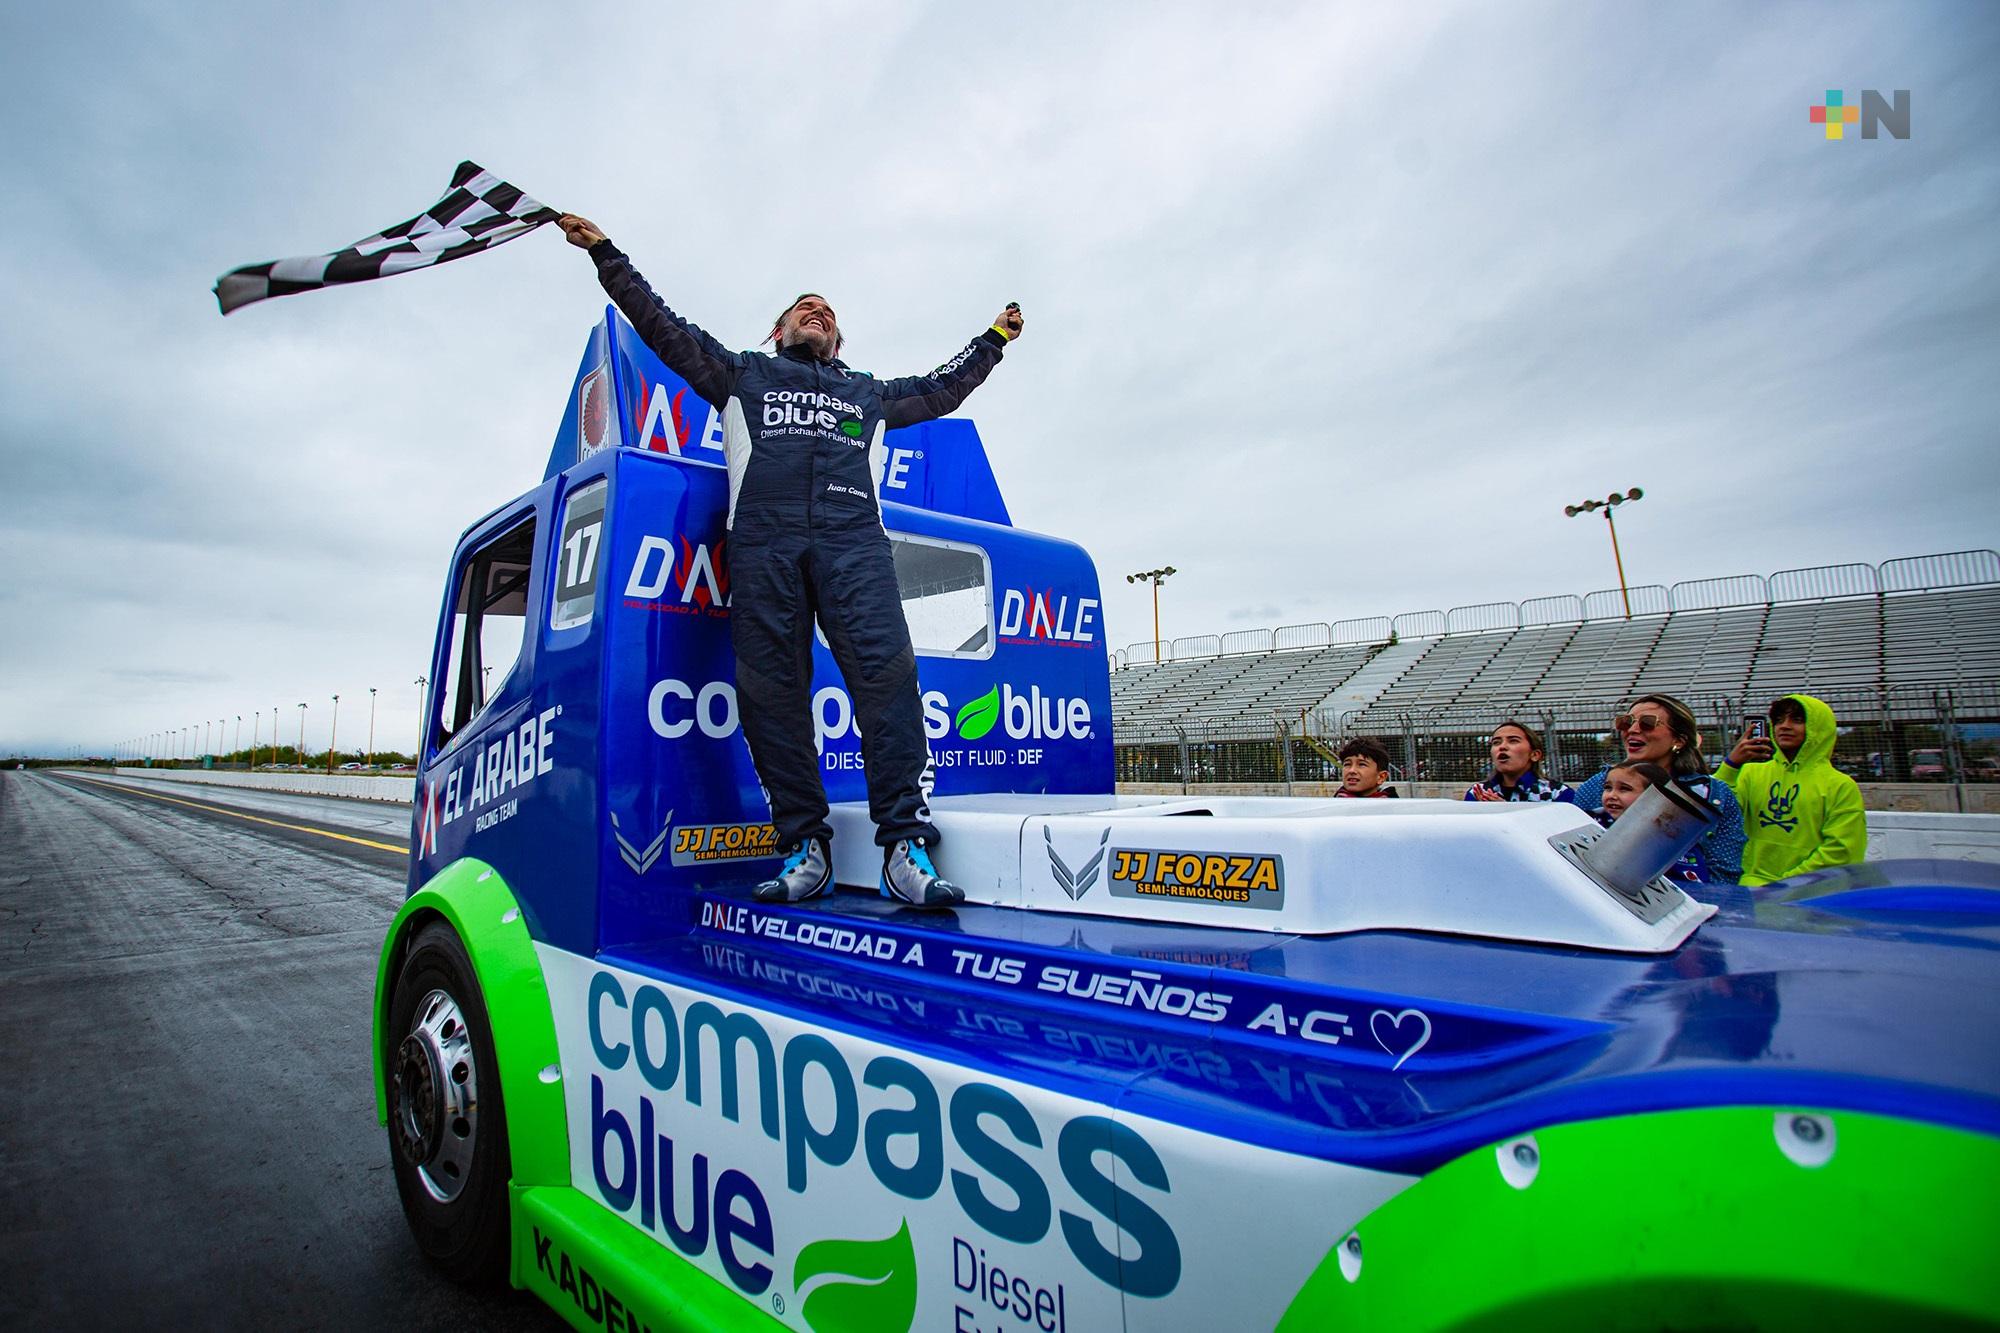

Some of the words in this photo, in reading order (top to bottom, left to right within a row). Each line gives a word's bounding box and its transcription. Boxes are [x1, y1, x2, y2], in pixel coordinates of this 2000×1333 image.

[762, 403, 838, 430] blue
[763, 390, 864, 420] compass
[760, 426, 786, 439] Diesel
[828, 432, 847, 444] Fluid
[827, 483, 847, 493] Juan
[565, 521, 602, 588] 17
[624, 535, 733, 608] DA
[999, 588, 1099, 642] DALE
[648, 679, 950, 756] cops
[1003, 683, 1091, 740] blue
[443, 766, 464, 825] EL
[469, 706, 556, 812] ARABE
[826, 752, 864, 770] DIES
[968, 750, 1007, 766] FLUID
[1018, 749, 1044, 766] DEF
[475, 808, 499, 834] RACING
[499, 798, 518, 826] TEAM
[675, 829, 707, 853] JJ
[709, 825, 780, 851] FORZ
[695, 847, 774, 861] SEMI-REMOLQUES
[1113, 852, 1149, 881] JJ
[1155, 854, 1279, 892] FORZA
[1136, 883, 1251, 902] SEMI-REMOLQUES
[701, 901, 749, 934] DALE
[751, 914, 897, 960] VELOCIDAD
[902, 943, 924, 967] A
[951, 950, 1026, 985] TUS
[1038, 966, 1233, 1022] SUEÑOS
[588, 970, 1182, 1299] compass
[590, 1074, 775, 1296] blue
[953, 1236, 1066, 1333] Diesel
